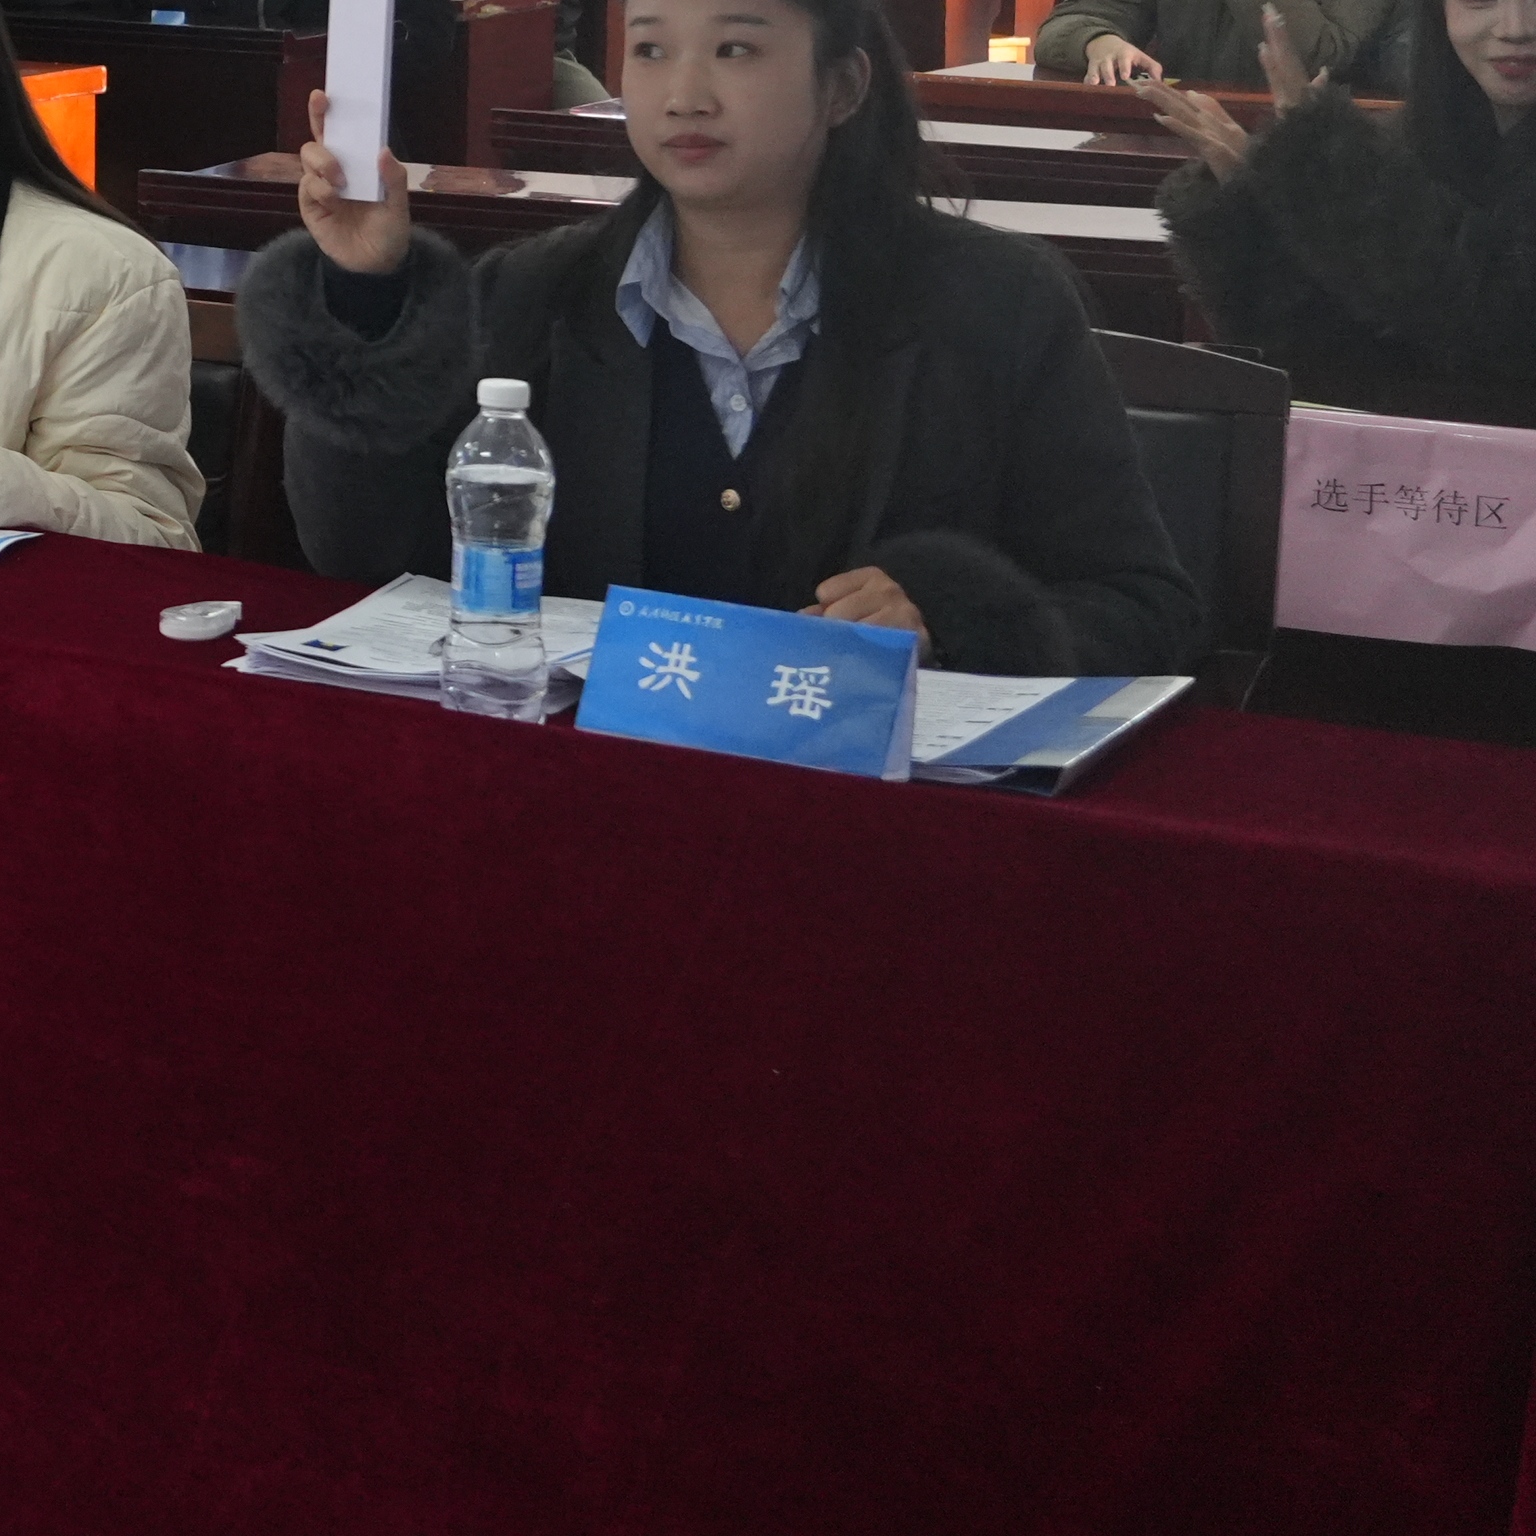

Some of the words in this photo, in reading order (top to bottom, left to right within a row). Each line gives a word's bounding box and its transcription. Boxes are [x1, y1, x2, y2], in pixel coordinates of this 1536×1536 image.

[1310, 478, 1509, 529] 选手等待区
